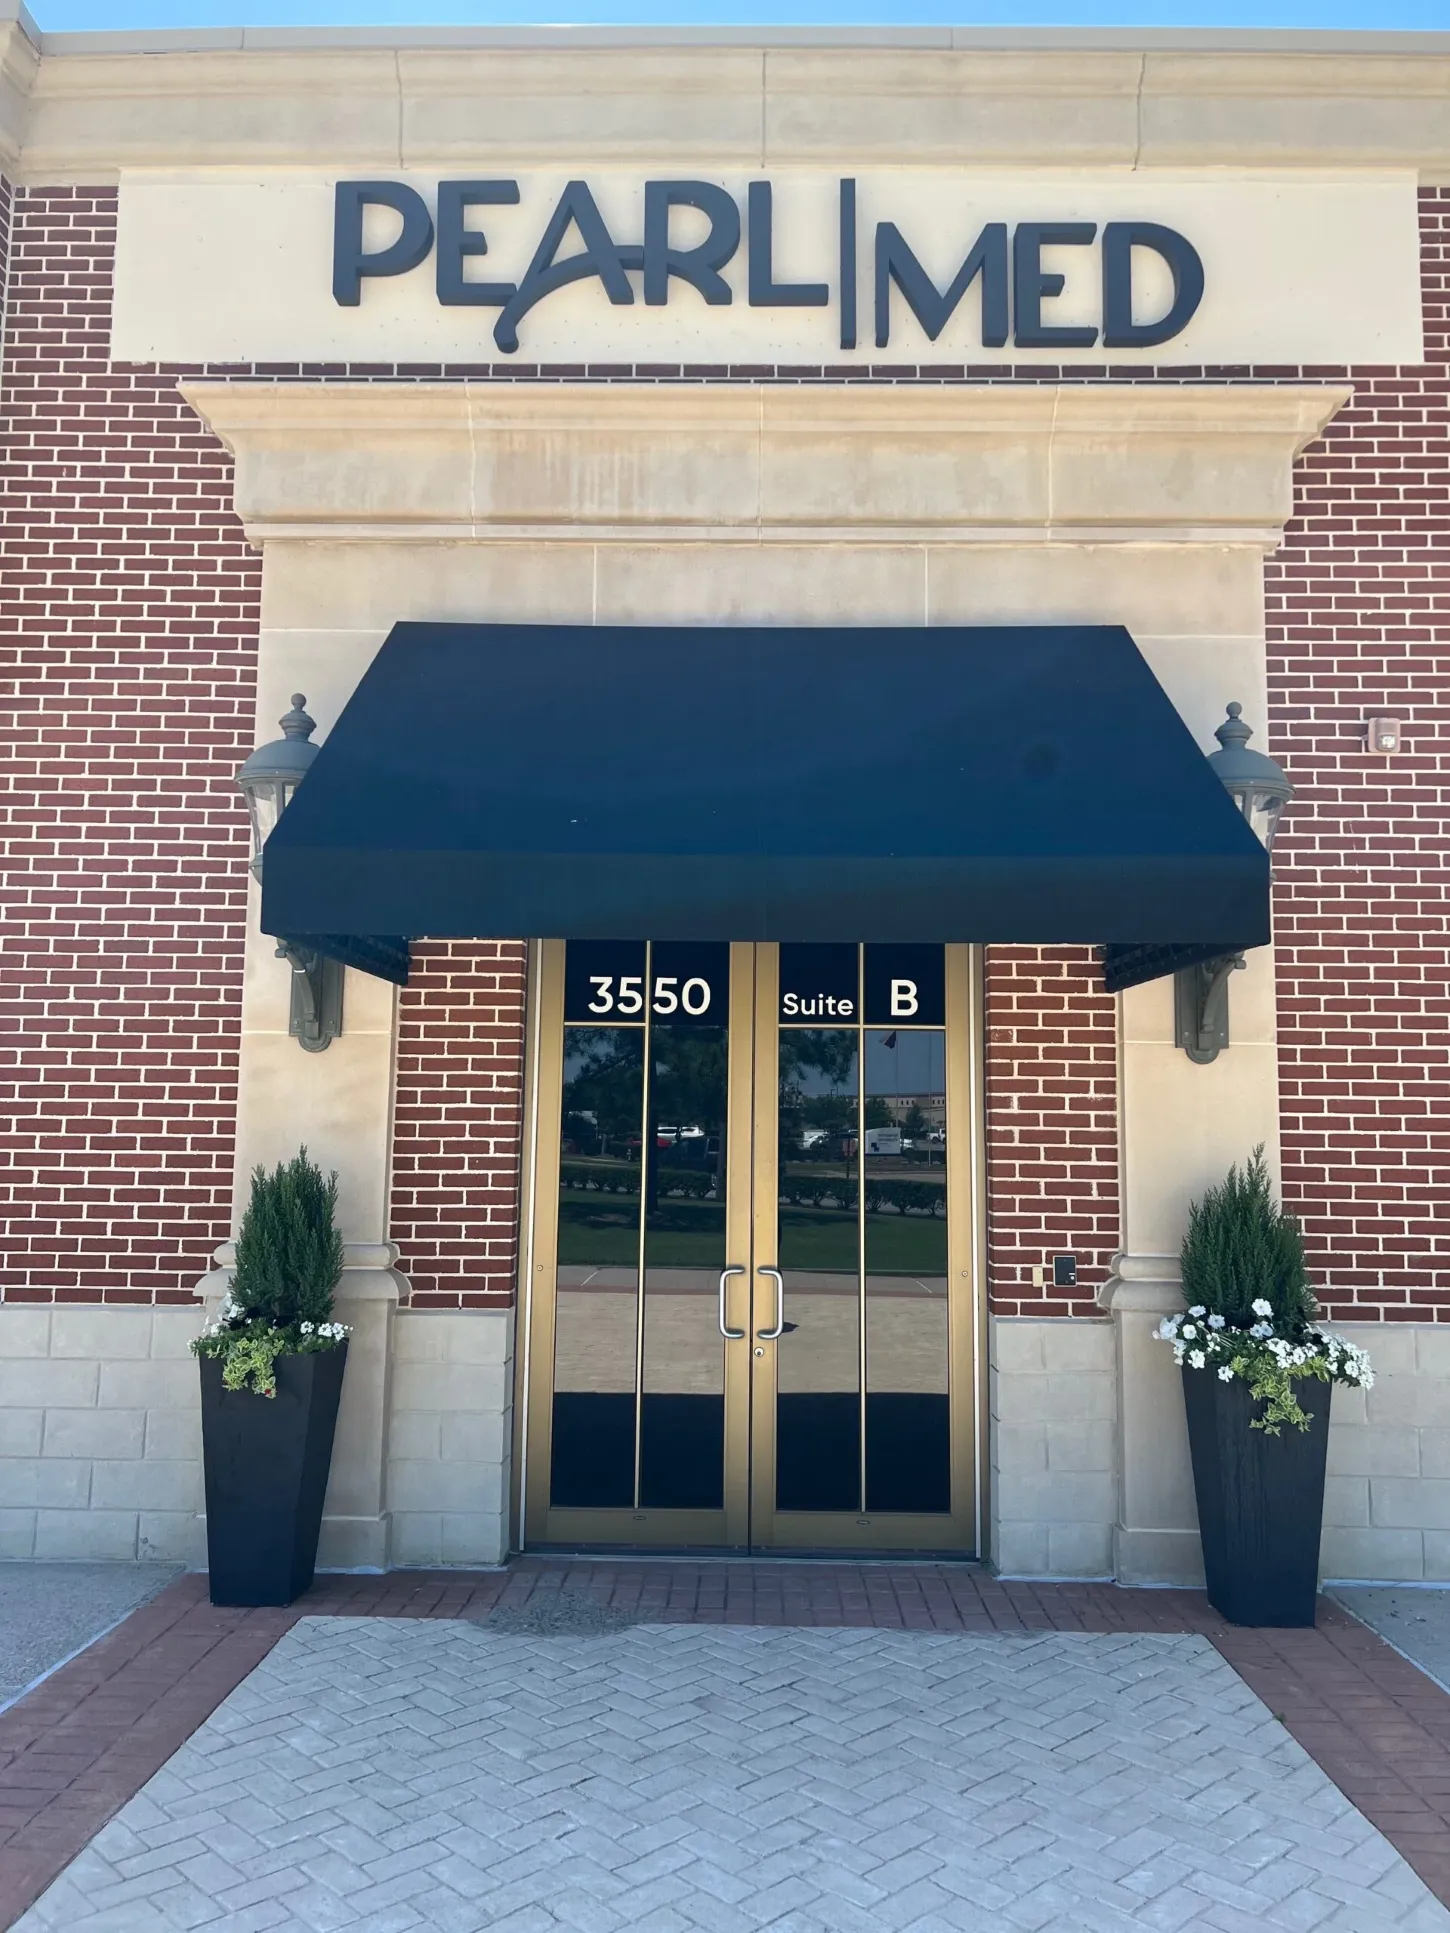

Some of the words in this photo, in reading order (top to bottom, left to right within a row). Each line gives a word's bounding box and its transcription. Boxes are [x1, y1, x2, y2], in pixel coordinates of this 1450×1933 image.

[587, 975, 712, 1016] 3550
[781, 992, 855, 1016] Suite
[889, 978, 920, 1017] B
